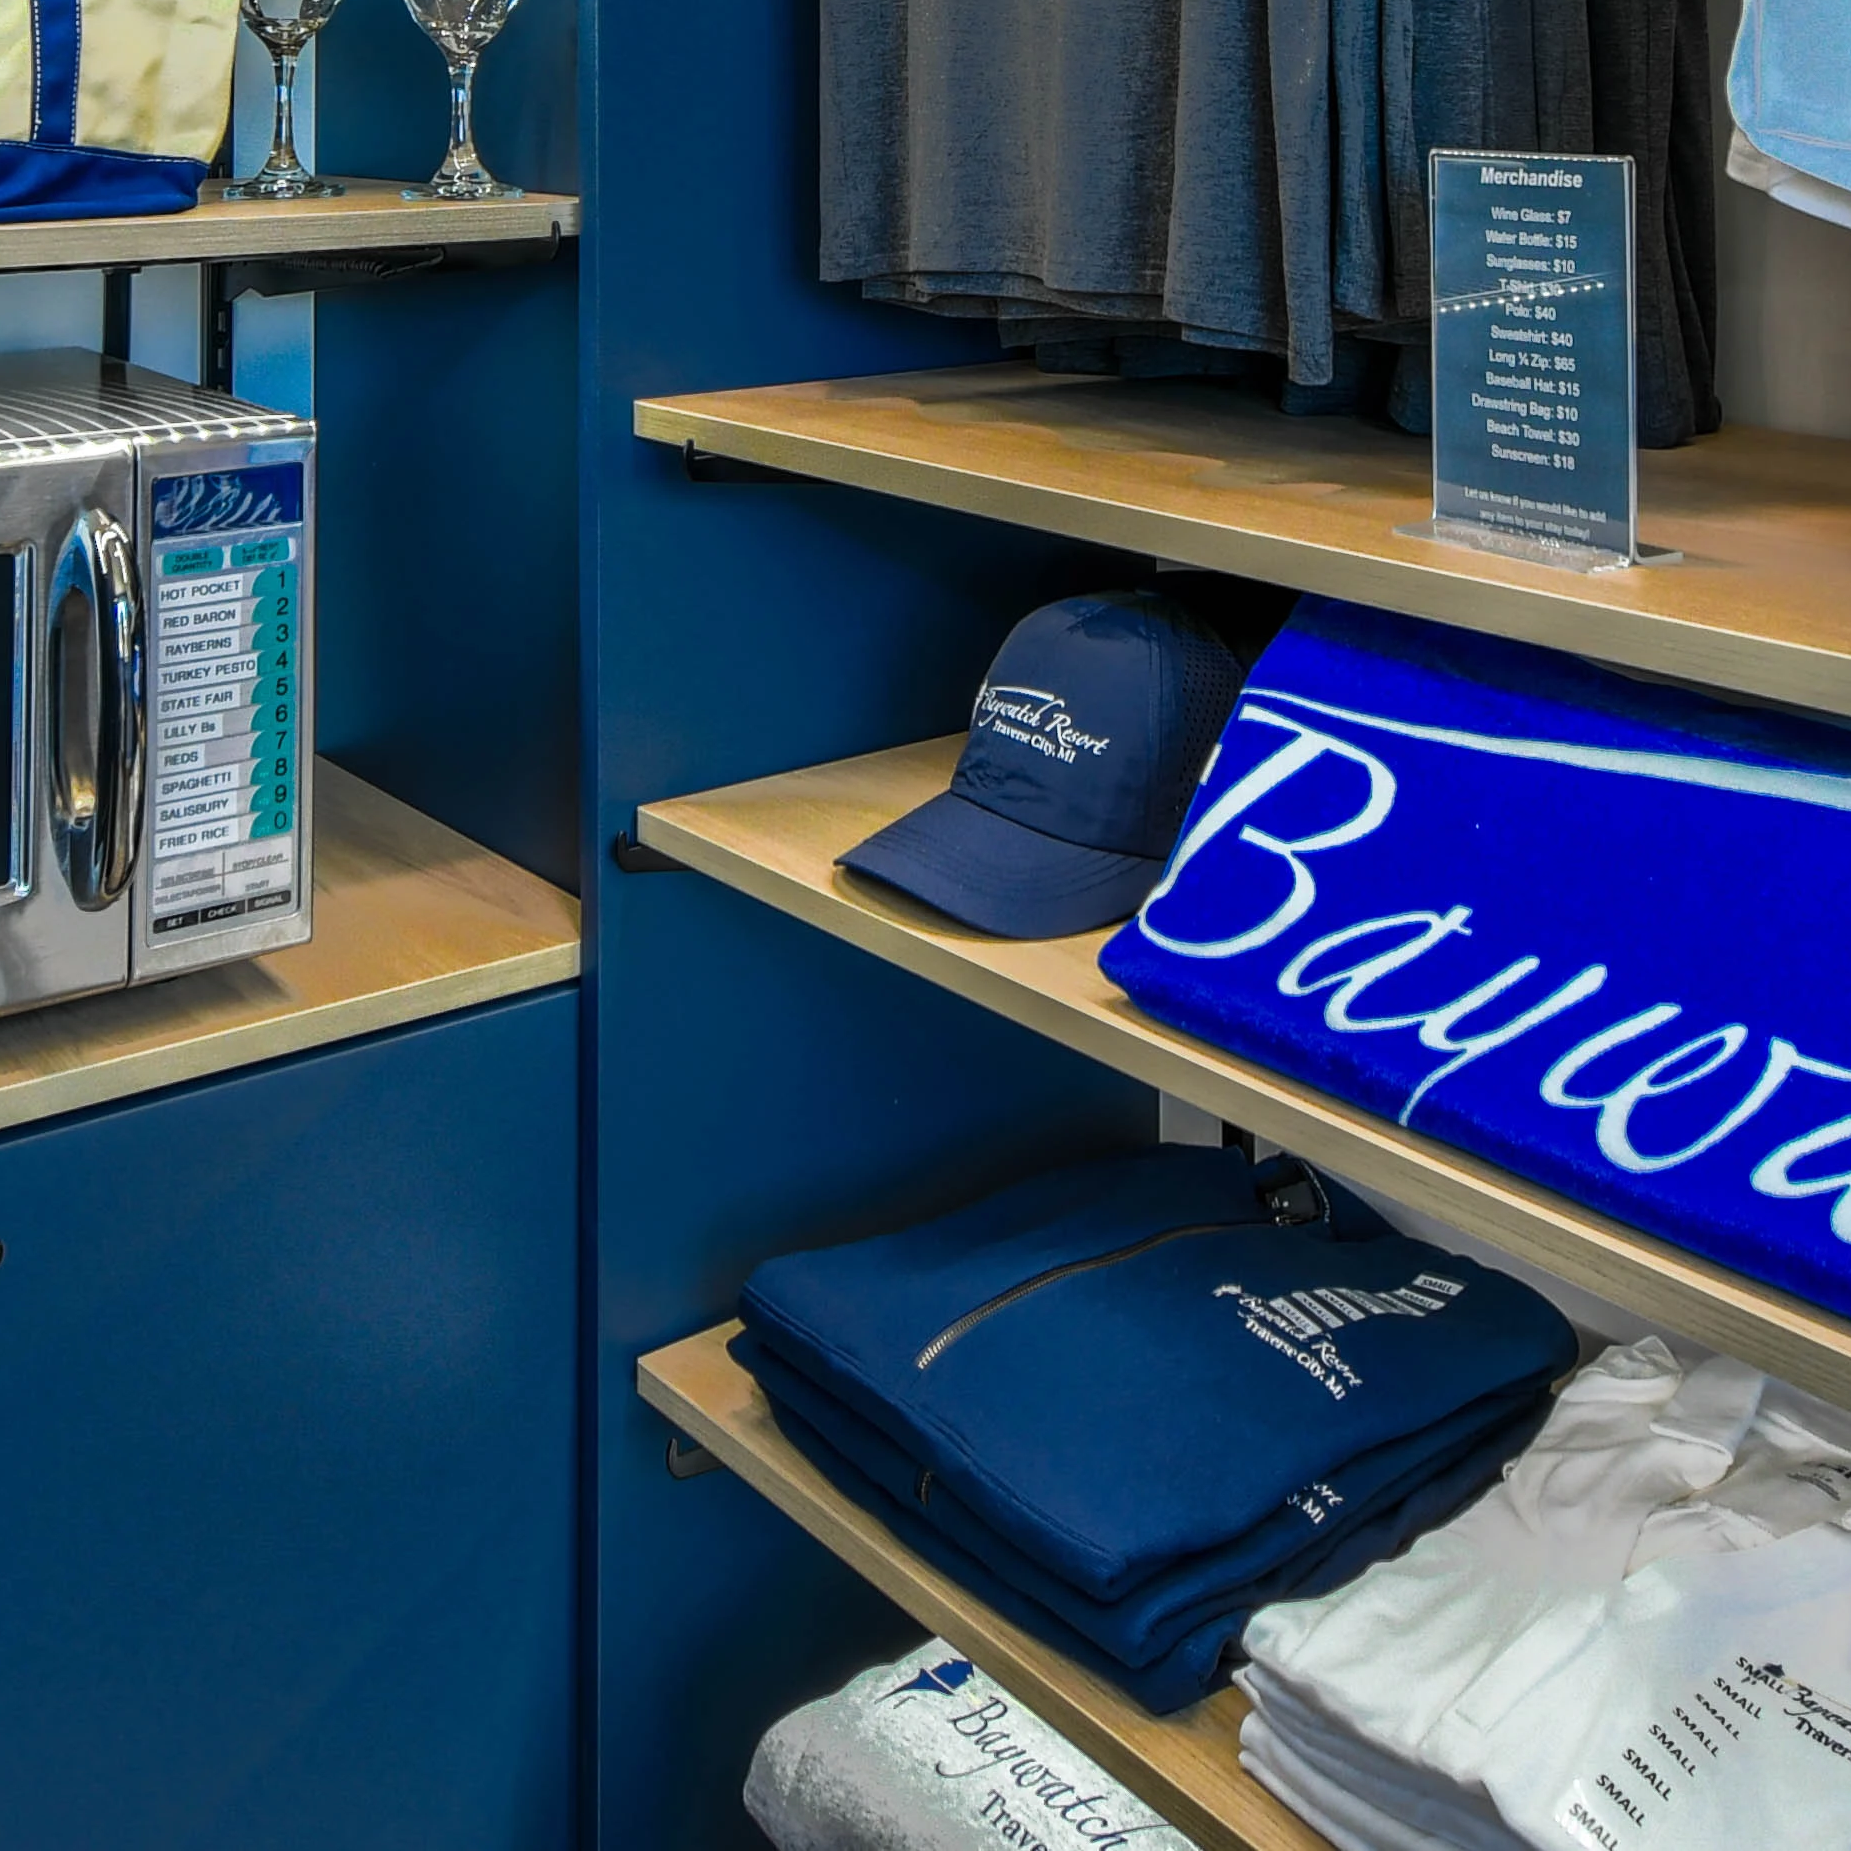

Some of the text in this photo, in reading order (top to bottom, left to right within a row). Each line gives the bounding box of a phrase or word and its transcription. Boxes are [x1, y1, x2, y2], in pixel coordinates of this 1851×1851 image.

[1480, 166, 1583, 188] Merchandise
[1491, 206, 1572, 225] Wine Glass: $7
[1485, 229, 1578, 250] Water Bottle: $15
[1486, 253, 1576, 274] Sunglasses: $10
[1505, 302, 1557, 321] Polo: $40
[1490, 324, 1574, 348] Sweatshirt: $40
[1489, 349, 1516, 368] Long
[1531, 354, 1551, 371] Zip:
[1554, 356, 1576, 372] $65
[1485, 371, 1532, 390] Baseball
[1558, 381, 1581, 397] $15
[1471, 393, 1579, 422] Drawstring Bag: $10
[1486, 419, 1581, 447] Beach Towel: $30
[1491, 443, 1576, 471] Sunscreen: $18
[277, 570, 285, 589] 1
[160, 580, 241, 602] HOT POCKET
[276, 597, 288, 616] 2
[163, 609, 236, 630] RED BARON
[276, 624, 289, 642] 3
[165, 637, 232, 657] RAYBERNS
[275, 651, 288, 668] 4
[161, 660, 256, 685] TURKEY PESTO
[276, 677, 288, 696] 5
[161, 691, 233, 713] STATE FAIR
[275, 704, 288, 723] 6
[163, 723, 197, 739] LILLY
[275, 731, 287, 749] 7
[1044, 713, 1110, 756] Resort
[164, 751, 198, 767] REDS
[1057, 748, 1076, 764] MI
[275, 758, 288, 777] 8
[161, 771, 231, 795] SPAGHETTI
[275, 784, 287, 803] 9
[160, 798, 229, 822] SALISBURY
[274, 811, 287, 830] 0
[159, 826, 229, 850] FRIED RICE
[207, 904, 238, 919] CHECK
[1325, 1375, 1347, 1401] MI
[1302, 1496, 1326, 1525] MI
[1735, 1656, 1784, 1695] SMALL
[1713, 1676, 1762, 1720] SMALL
[1694, 1692, 1741, 1741] SMALL
[1672, 1705, 1720, 1758] SMALL
[1648, 1723, 1696, 1778] SMALL
[1621, 1747, 1672, 1802] SMALL
[1596, 1773, 1646, 1828] SMALL
[1568, 1801, 1621, 1851] SMALL
